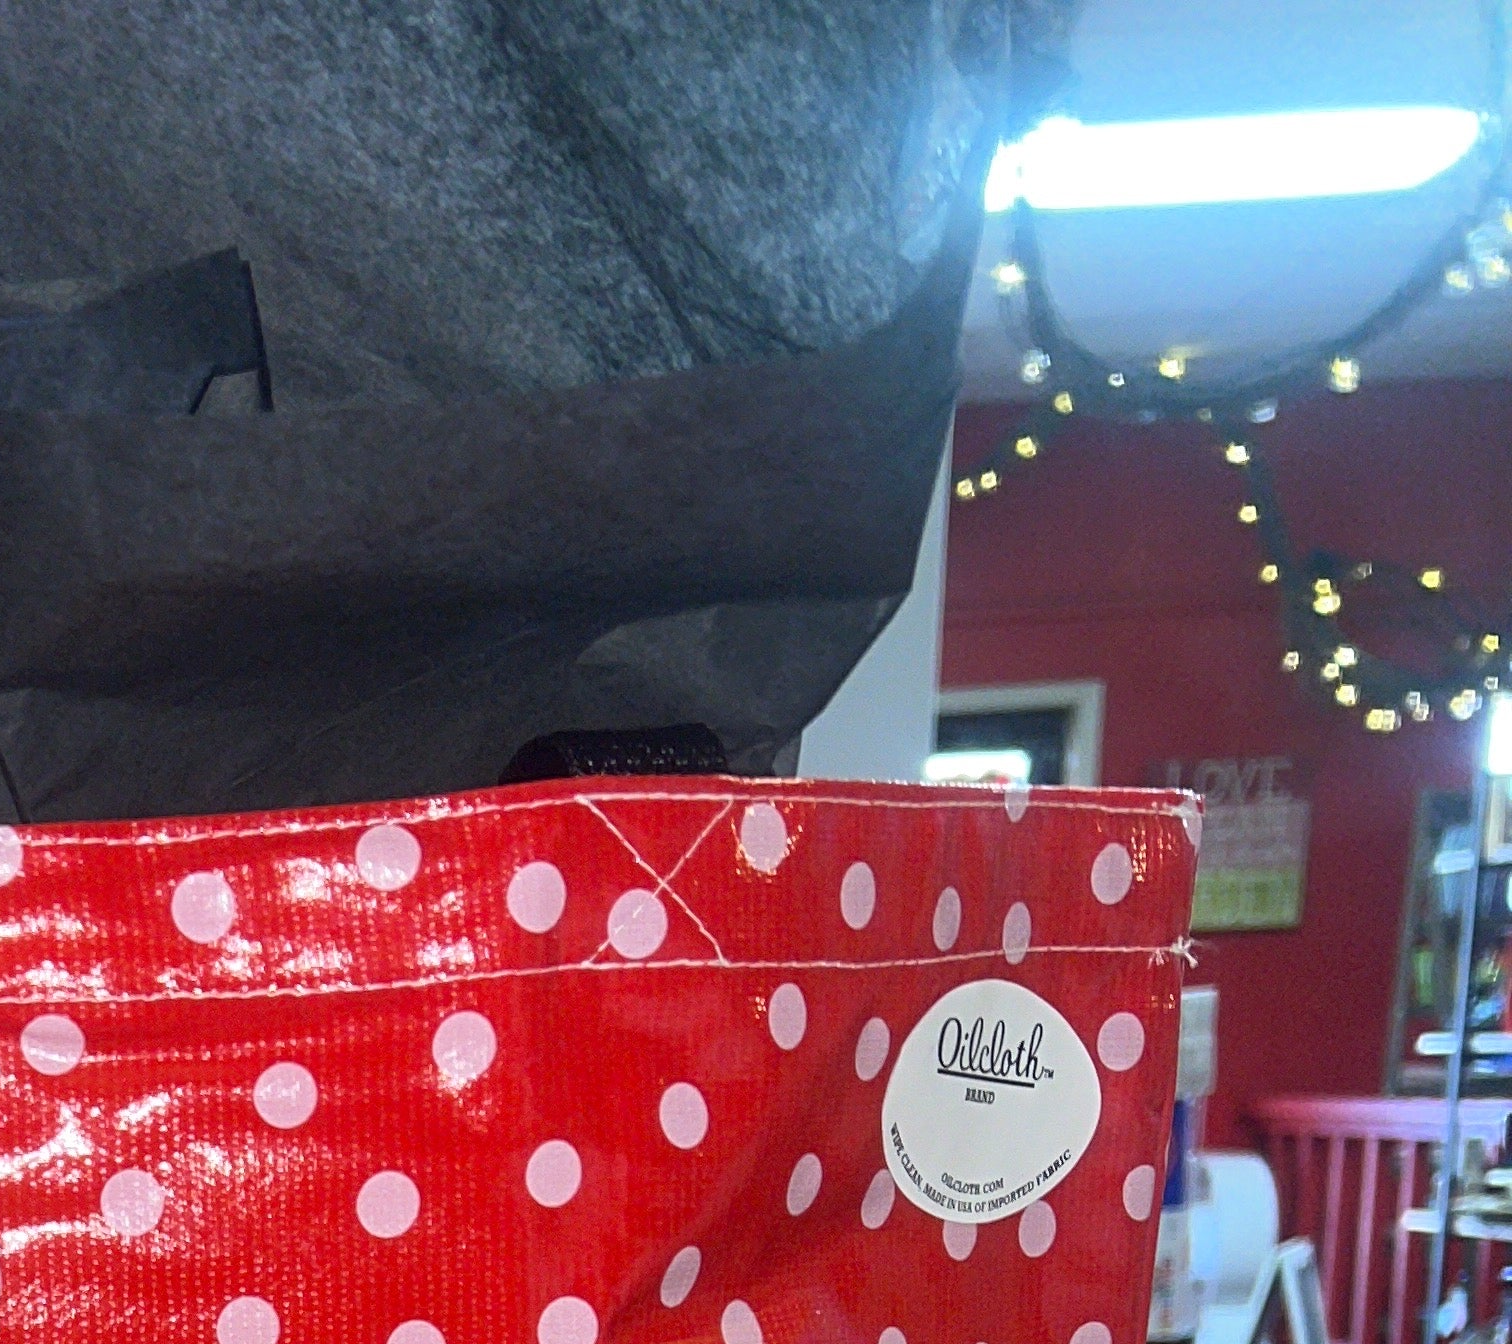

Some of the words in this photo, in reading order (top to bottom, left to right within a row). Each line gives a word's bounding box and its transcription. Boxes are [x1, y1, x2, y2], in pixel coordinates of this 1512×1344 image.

[965, 1088, 995, 1104] BRAND
[923, 1182, 947, 1207] MADE
[947, 1197, 956, 1209] IN
[974, 1201, 986, 1213] OF
[988, 1181, 1035, 1212] IMPORTED
[1035, 1148, 1072, 1186] FABRIC
